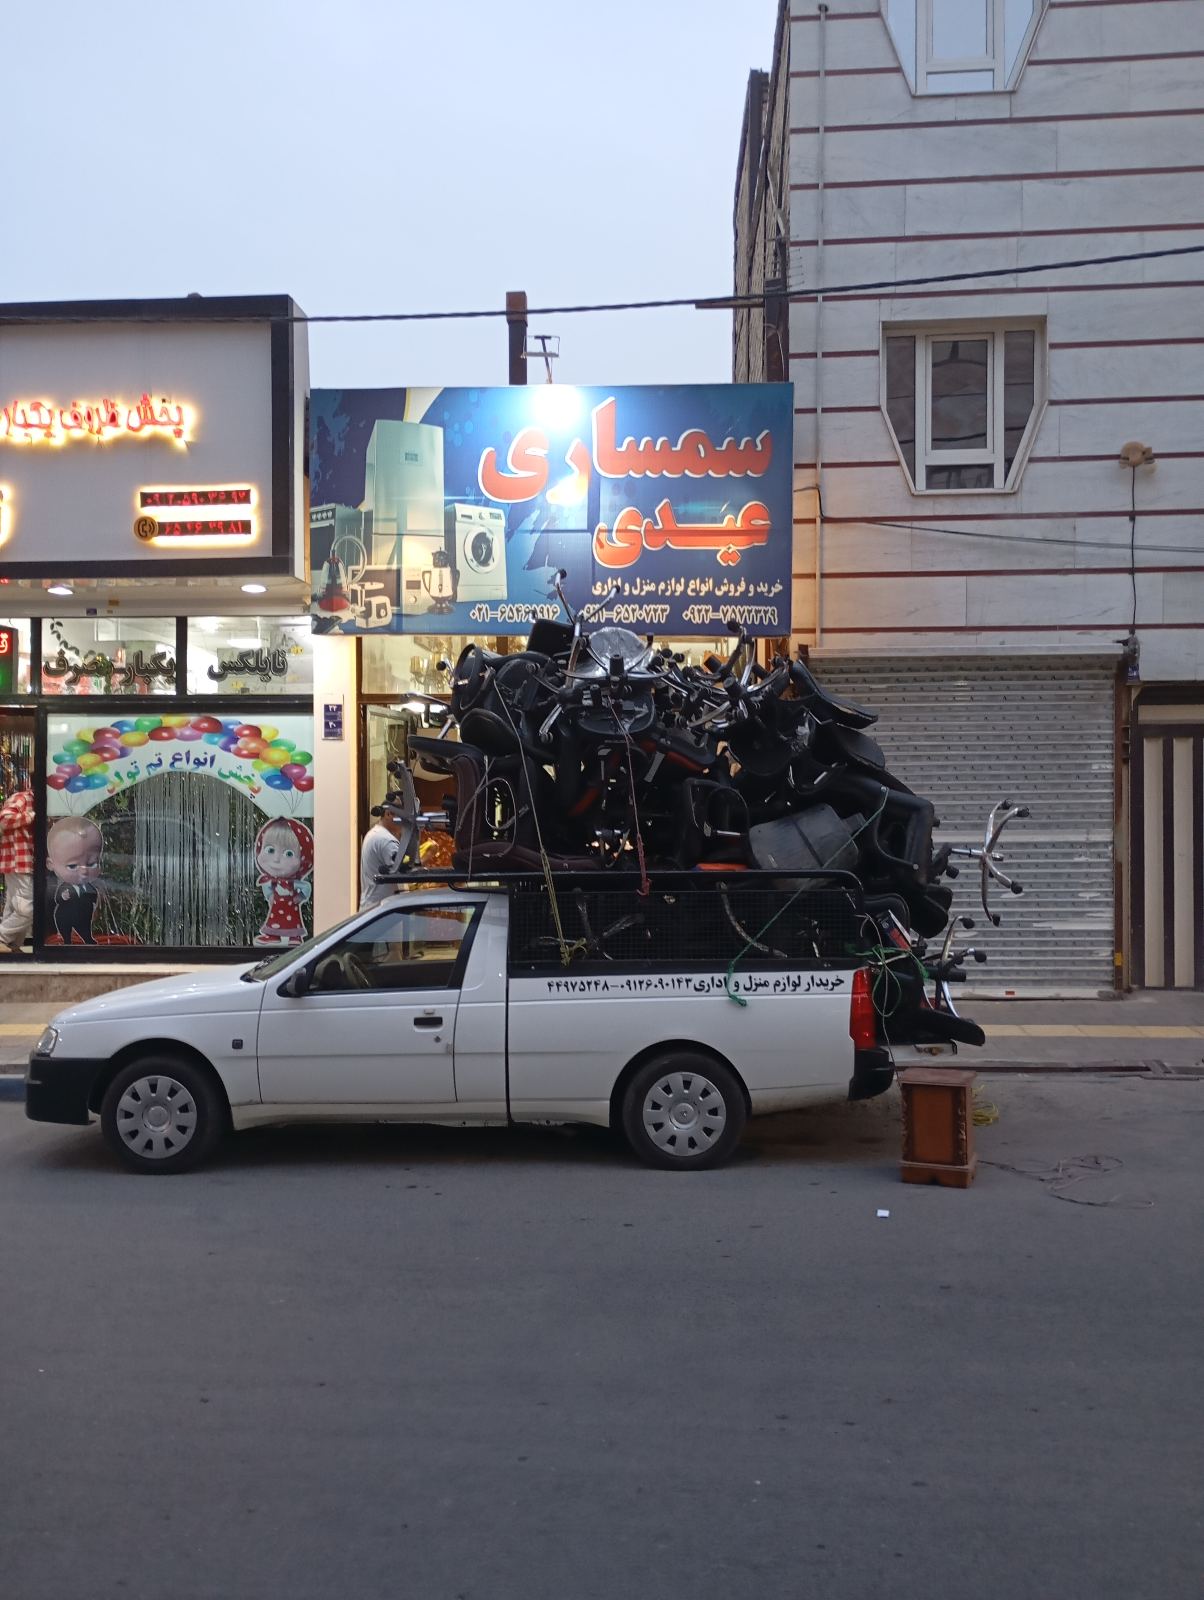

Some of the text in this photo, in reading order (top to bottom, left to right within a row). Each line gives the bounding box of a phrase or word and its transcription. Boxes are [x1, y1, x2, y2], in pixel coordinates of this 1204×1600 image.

[59, 398, 121, 436] ظروف
[478, 395, 773, 504] سمساری
[591, 496, 773, 569] عیدی
[623, 583, 630, 596] و
[632, 576, 656, 596] منزل
[657, 576, 685, 597] لوازم
[687, 576, 713, 596] انواع
[715, 576, 746, 597] فروش
[748, 583, 755, 597] و
[756, 578, 784, 598] خرید
[43, 648, 115, 686] صرف
[119, 649, 177, 686] یکبار
[145, 752, 163, 776] تم
[168, 749, 216, 770] انواع
[693, 975, 728, 993] اداری
[733, 980, 740, 992] و
[743, 975, 770, 993] منزل
[773, 974, 802, 993] لوازم
[805, 974, 846, 993] خریدار
